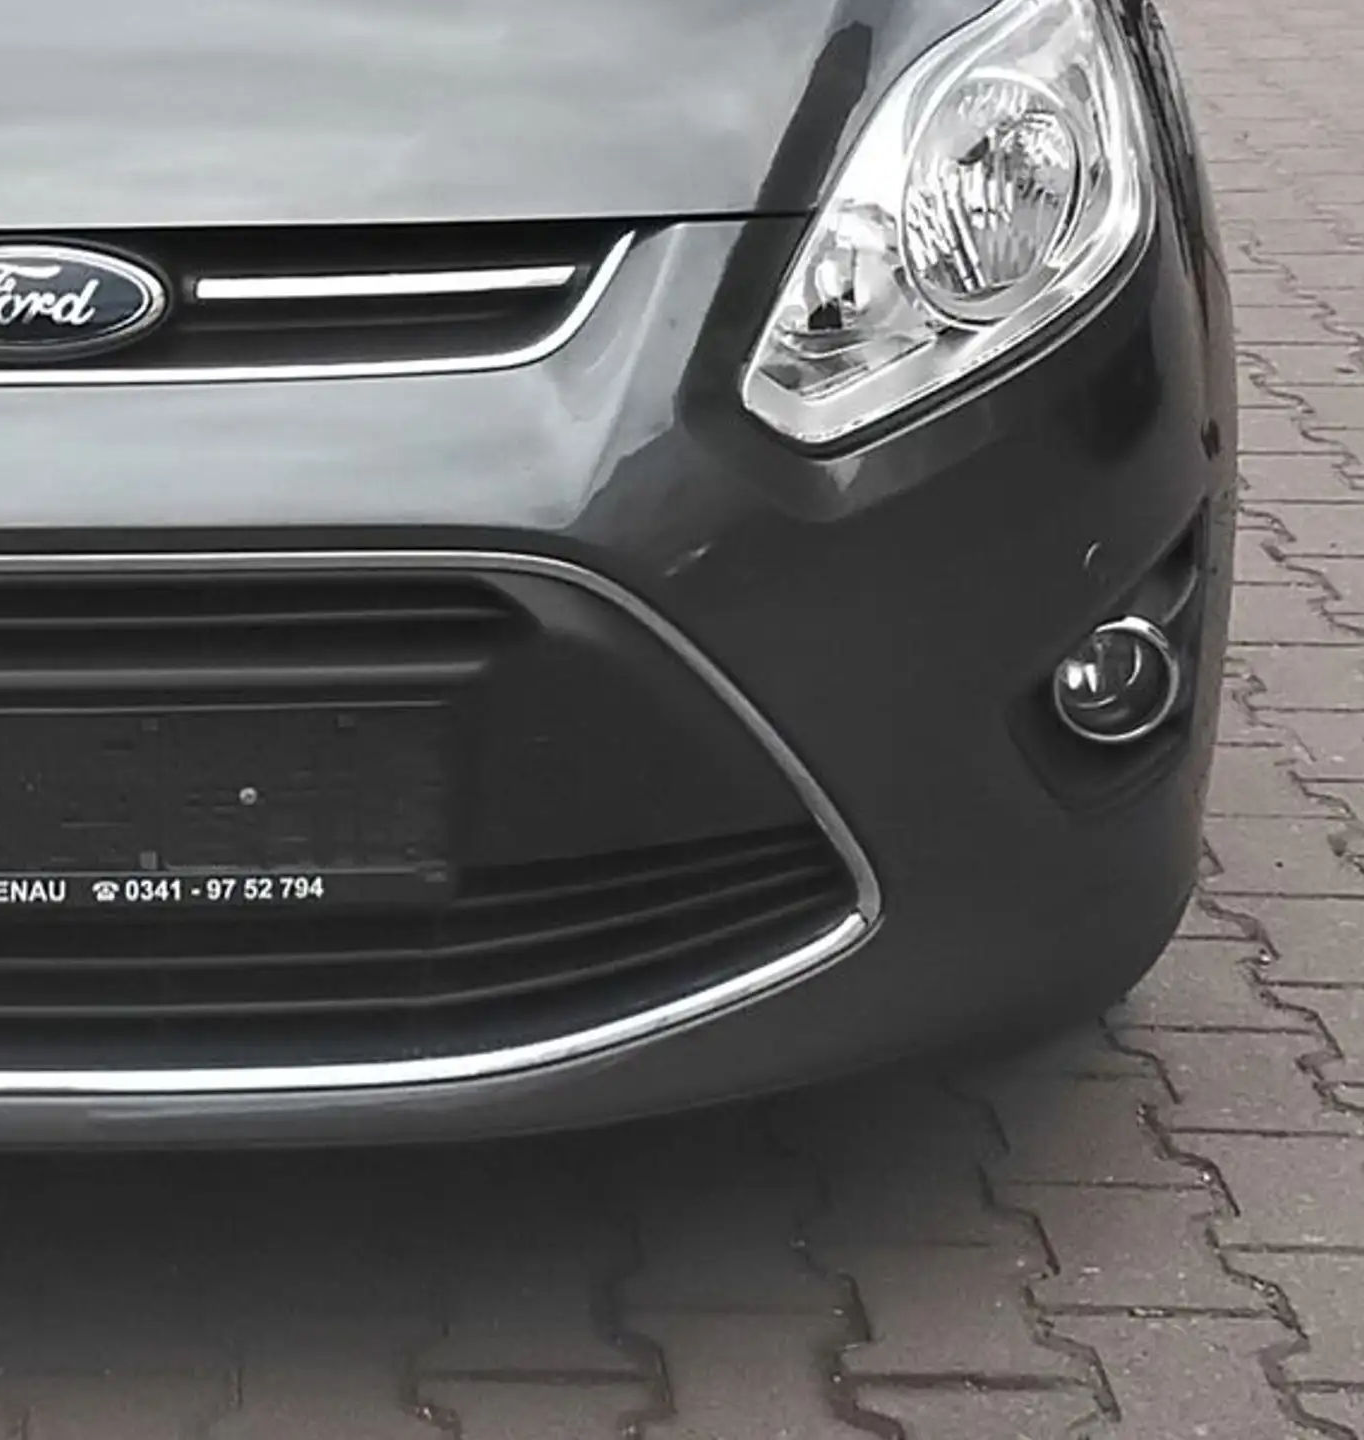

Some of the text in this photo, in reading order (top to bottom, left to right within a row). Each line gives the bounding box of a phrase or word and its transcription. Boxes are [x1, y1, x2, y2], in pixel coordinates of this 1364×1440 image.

[125, 879, 182, 901] 0341
[207, 878, 235, 900] 97
[244, 878, 272, 900] 52
[280, 877, 324, 899] 794
